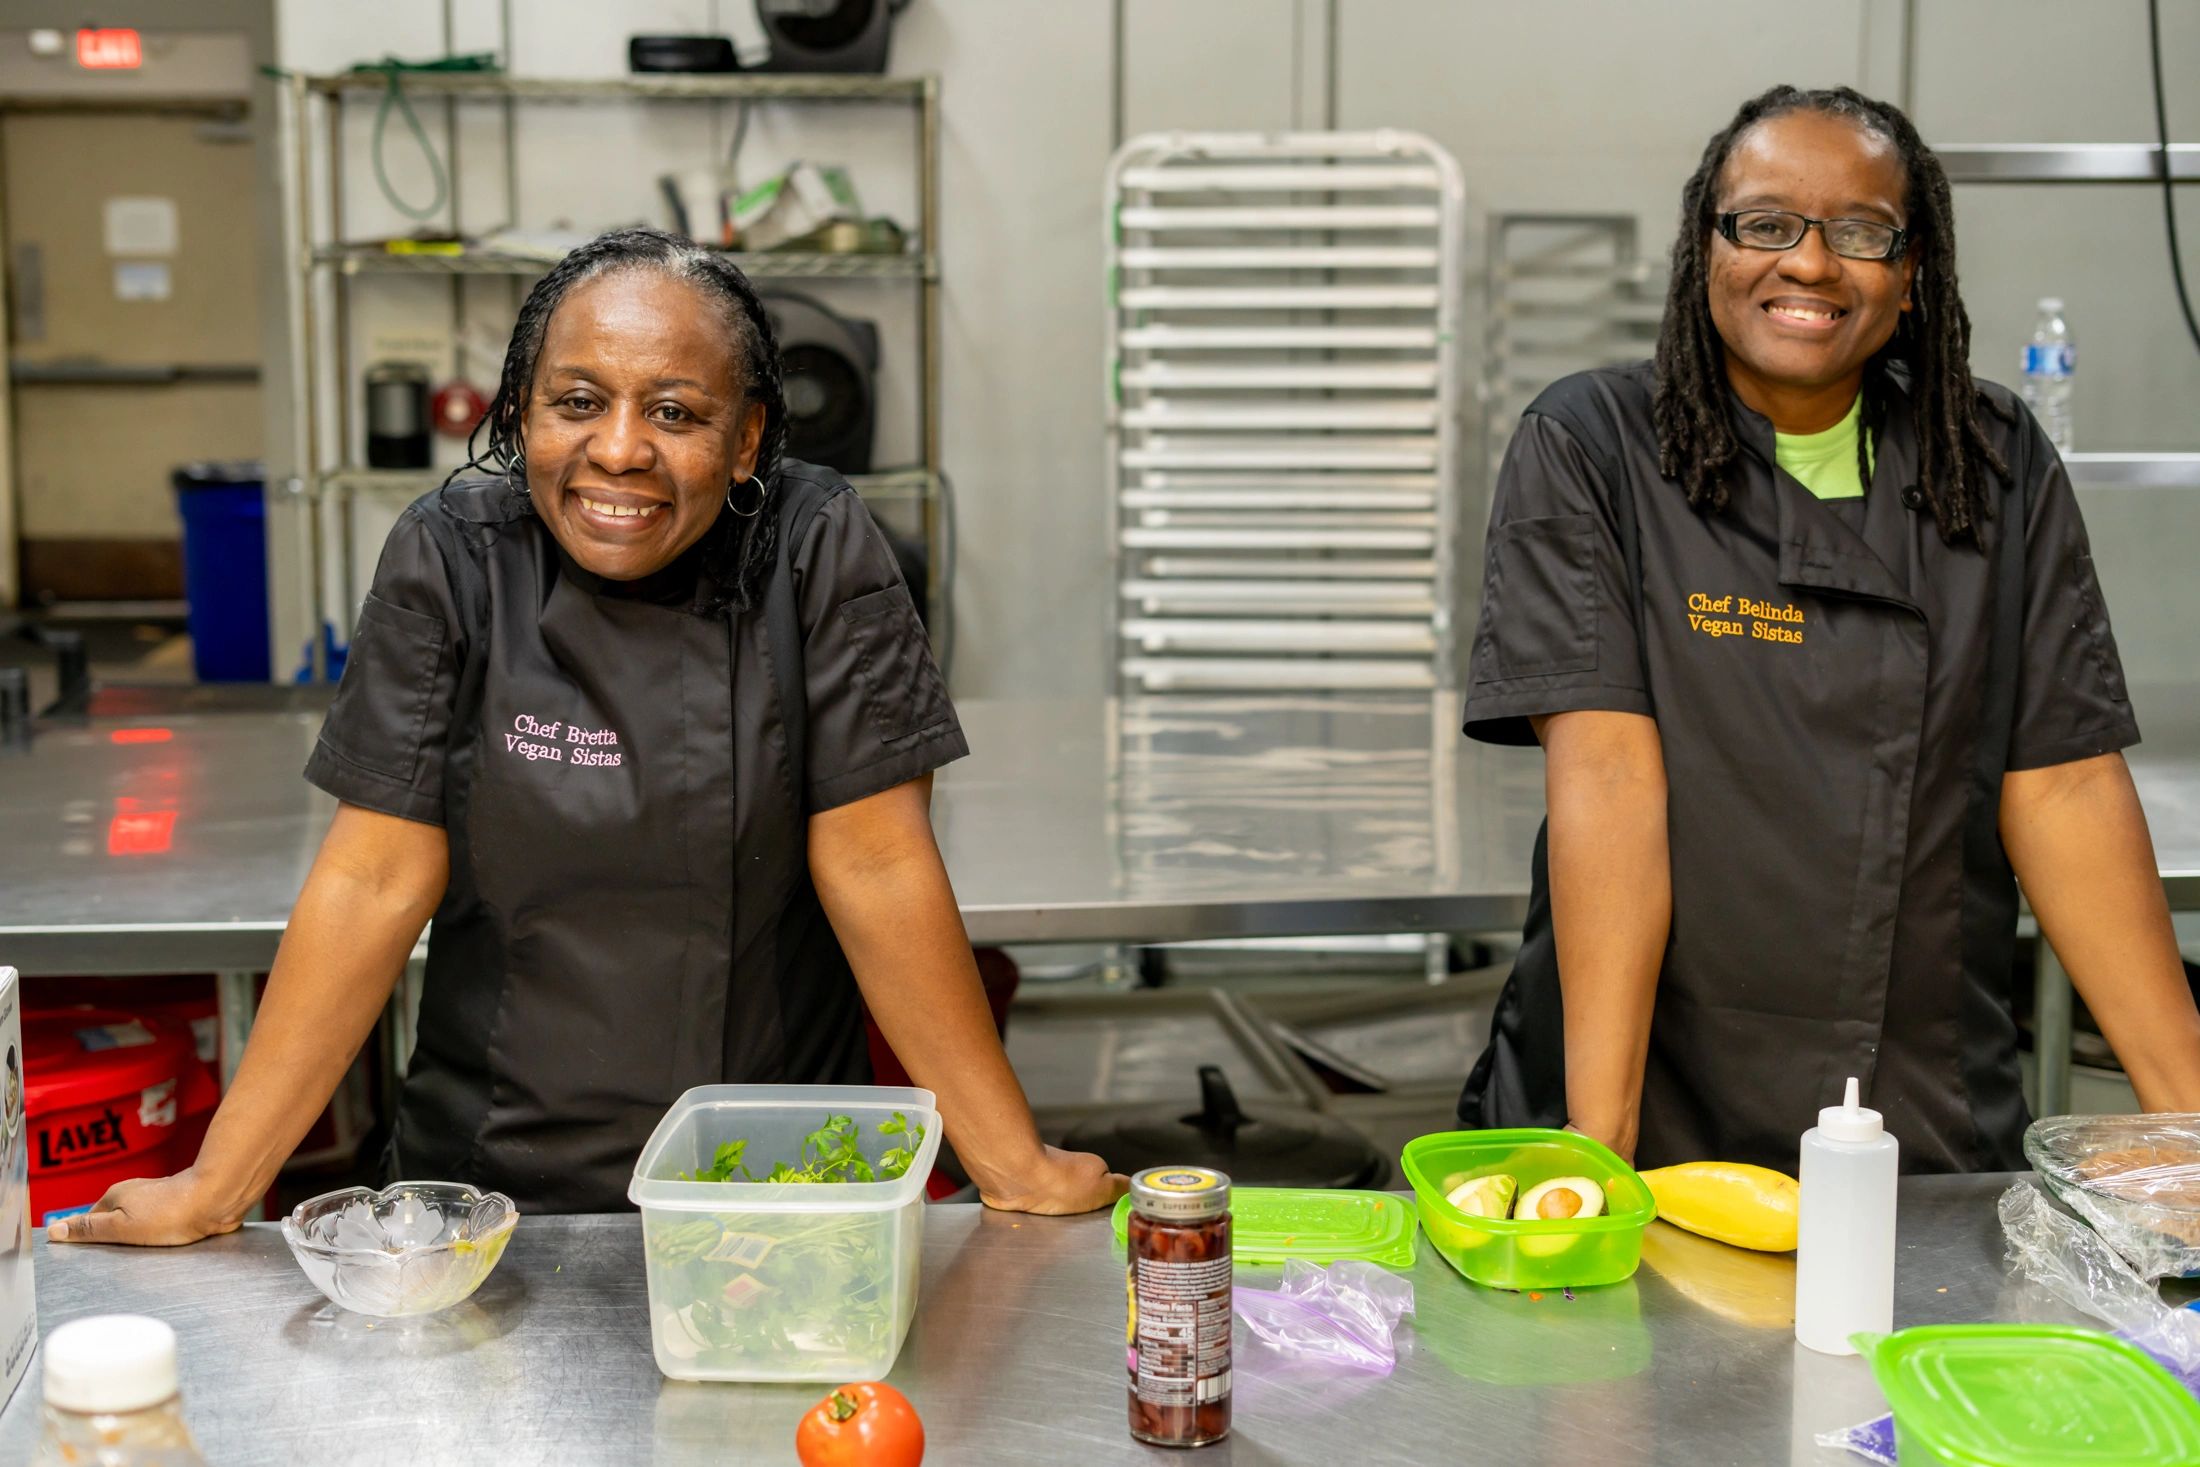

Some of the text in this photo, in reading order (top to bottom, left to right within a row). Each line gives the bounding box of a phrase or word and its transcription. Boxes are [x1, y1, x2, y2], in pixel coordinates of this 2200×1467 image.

[1688, 593, 1805, 623] Chef Belinda
[1687, 613, 1803, 644] Vegan Sistas
[514, 714, 618, 745] Chef Bretta
[504, 733, 621, 766] Vegan Sistas
